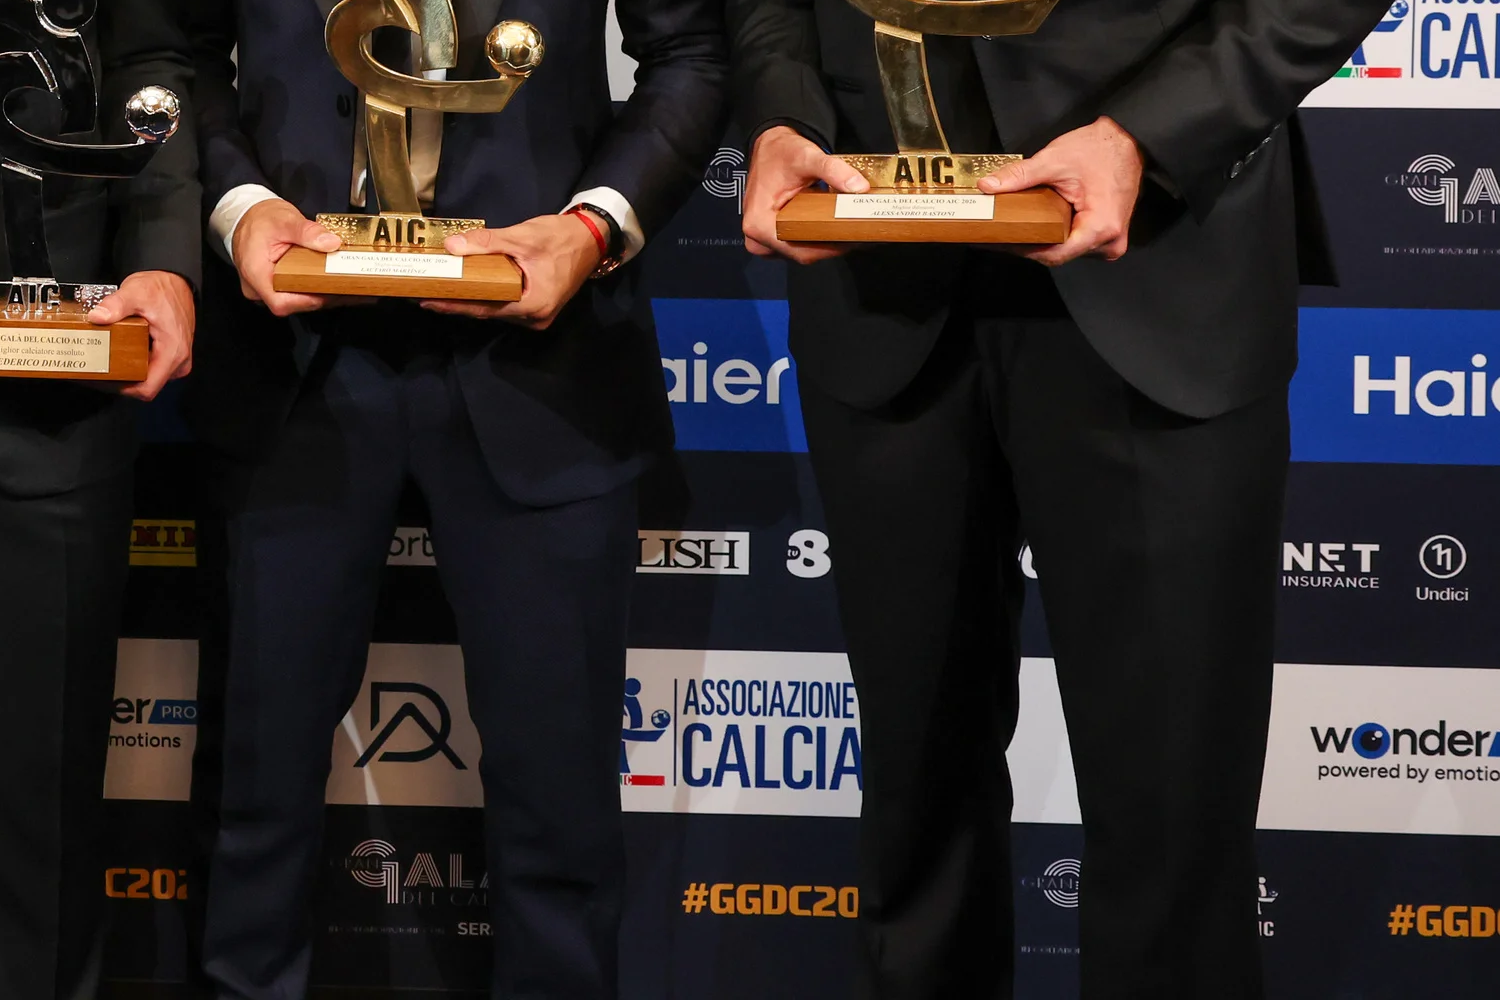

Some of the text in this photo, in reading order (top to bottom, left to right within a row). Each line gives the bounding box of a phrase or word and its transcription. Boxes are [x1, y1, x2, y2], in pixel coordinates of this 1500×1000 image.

[894, 156, 954, 185] AIC
[373, 218, 426, 246] AIC
[6, 283, 61, 311] AIC
[0, 332, 22, 342] GALÀ
[24, 335, 40, 343] DEL
[40, 336, 70, 345] CALCIO
[71, 337, 86, 345] AIC
[86, 338, 102, 346] 2026
[21, 346, 55, 355] calciatore
[56, 347, 85, 357] assoluto
[41, 359, 87, 368] DIMARCO
[664, 341, 789, 405] aier
[1354, 353, 1500, 417] Hai
[637, 538, 740, 570] LISH
[1282, 542, 1380, 574] NET
[1282, 575, 1380, 589] INSURANCE
[1415, 586, 1469, 602] Undici
[683, 678, 855, 719] ASSOCIAZIONE
[109, 732, 181, 750] motions
[1311, 720, 1490, 760] wonder
[681, 722, 863, 791] CALCIA
[1317, 762, 1500, 784] powered by emotio
